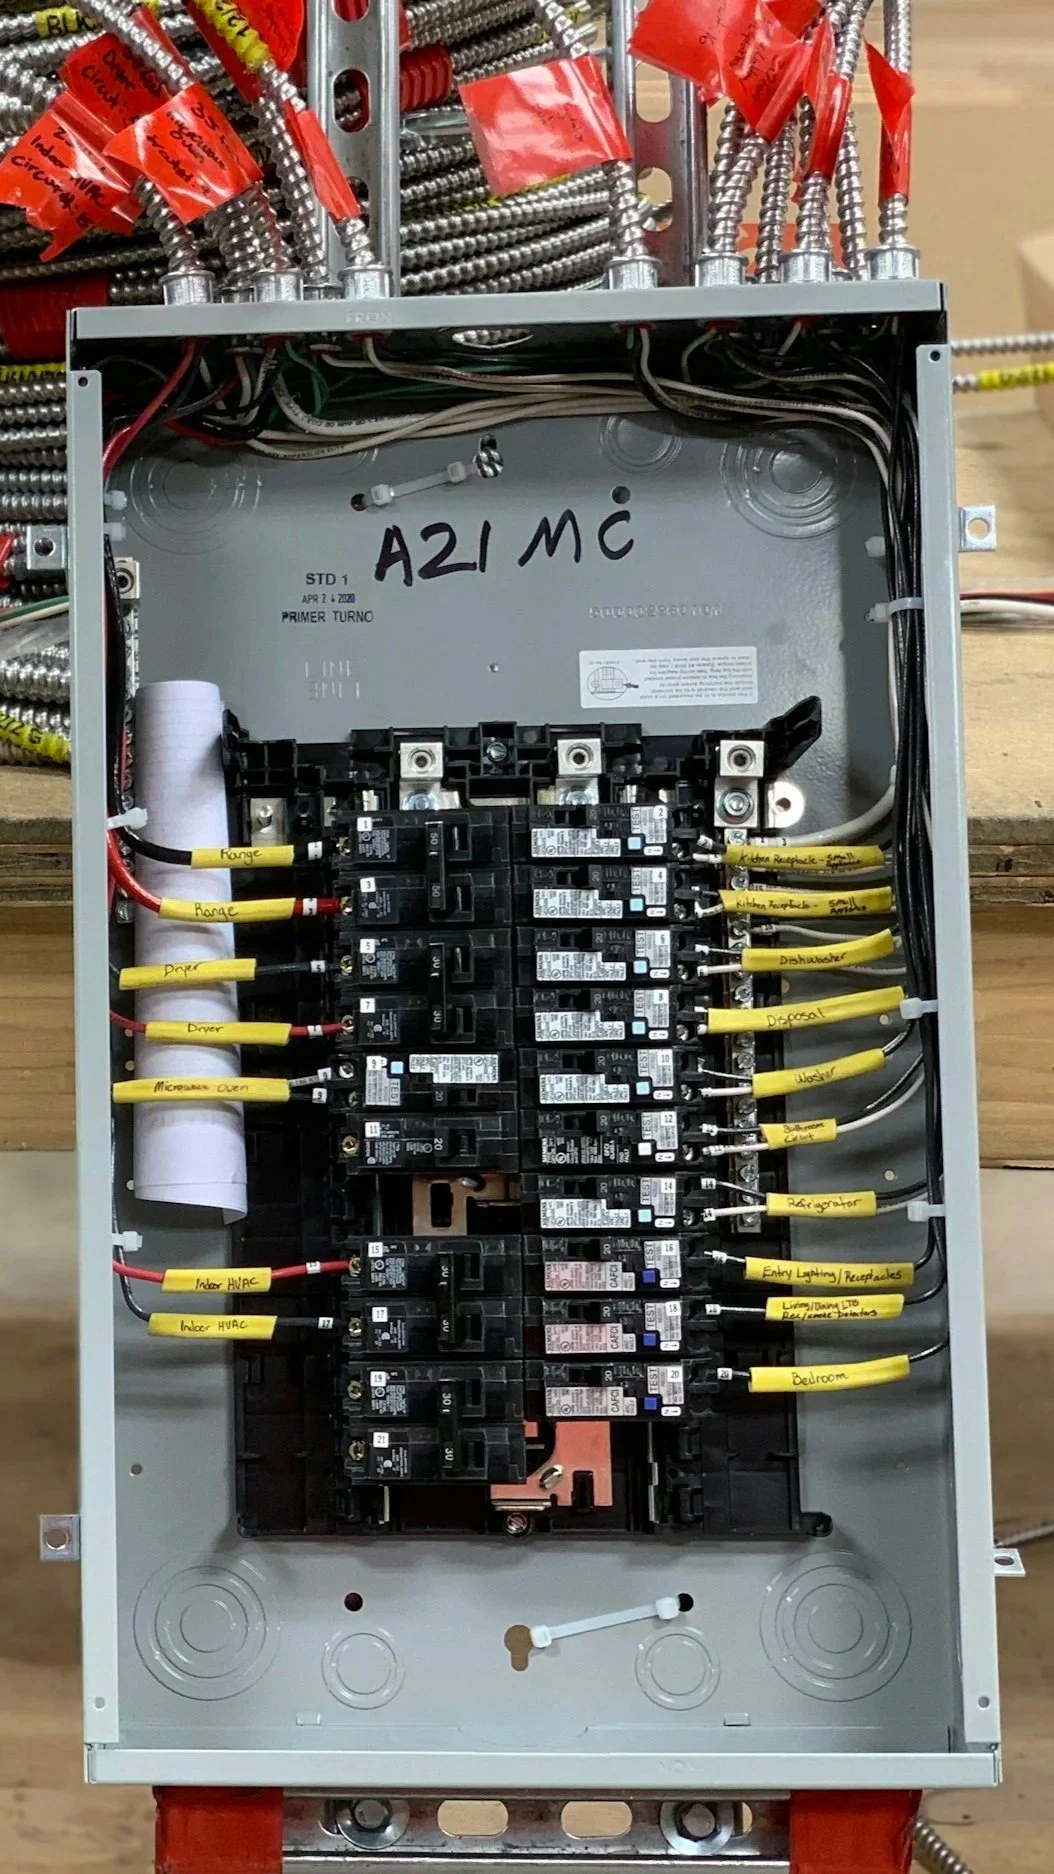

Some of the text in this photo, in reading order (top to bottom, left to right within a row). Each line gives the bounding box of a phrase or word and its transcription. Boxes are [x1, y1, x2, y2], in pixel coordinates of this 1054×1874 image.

[375, 520, 492, 587] A21
[306, 573, 348, 585] STD 1
[302, 594, 318, 604] APR
[281, 610, 373, 623] PRIMER TURNO
[658, 808, 664, 816] 2
[363, 821, 368, 829] 1
[632, 808, 640, 830] TEST
[740, 851, 770, 864] Kitchen
[632, 869, 640, 891] TEST
[657, 872, 663, 880] 4
[366, 881, 371, 889] 3
[195, 903, 239, 918] Range
[637, 931, 645, 956] TEST
[779, 952, 847, 965] Dishwasher
[163, 962, 201, 977] Dryer
[636, 990, 644, 1014] TEST
[767, 1008, 825, 1028] Disposal
[187, 1023, 224, 1034] Dryer
[640, 1050, 648, 1073] TEST
[661, 1054, 670, 1063] 10
[794, 1066, 836, 1085] Washer
[217, 1084, 248, 1093] Oven
[390, 1081, 399, 1104] TEST
[435, 1090, 443, 1101] 20
[664, 1114, 673, 1123] 12
[369, 1125, 378, 1134] 11
[434, 1138, 443, 1150] 20
[600, 1182, 608, 1193] 20
[642, 1179, 650, 1202] TEST
[664, 1182, 672, 1190] 14
[787, 1196, 862, 1213] Refrigerator
[603, 1243, 611, 1254] 20
[646, 1243, 654, 1266] TEST
[665, 1244, 674, 1252] 16
[610, 1265, 618, 1288] CAFCI
[762, 1265, 792, 1281] Entry
[195, 1278, 260, 1290] Indoor HVAC
[603, 1306, 611, 1317] 20
[669, 1304, 678, 1312] 18
[647, 1304, 655, 1327] TEST
[180, 1320, 248, 1333] Indoor HVAC
[374, 1374, 382, 1383] 19
[605, 1370, 612, 1381] 20
[650, 1368, 658, 1390] TEST
[670, 1370, 679, 1379] 20
[792, 1371, 848, 1386] Bedroom
[442, 1392, 451, 1405] 30
[376, 1435, 385, 1444] 21
[444, 1448, 454, 1461] 30
